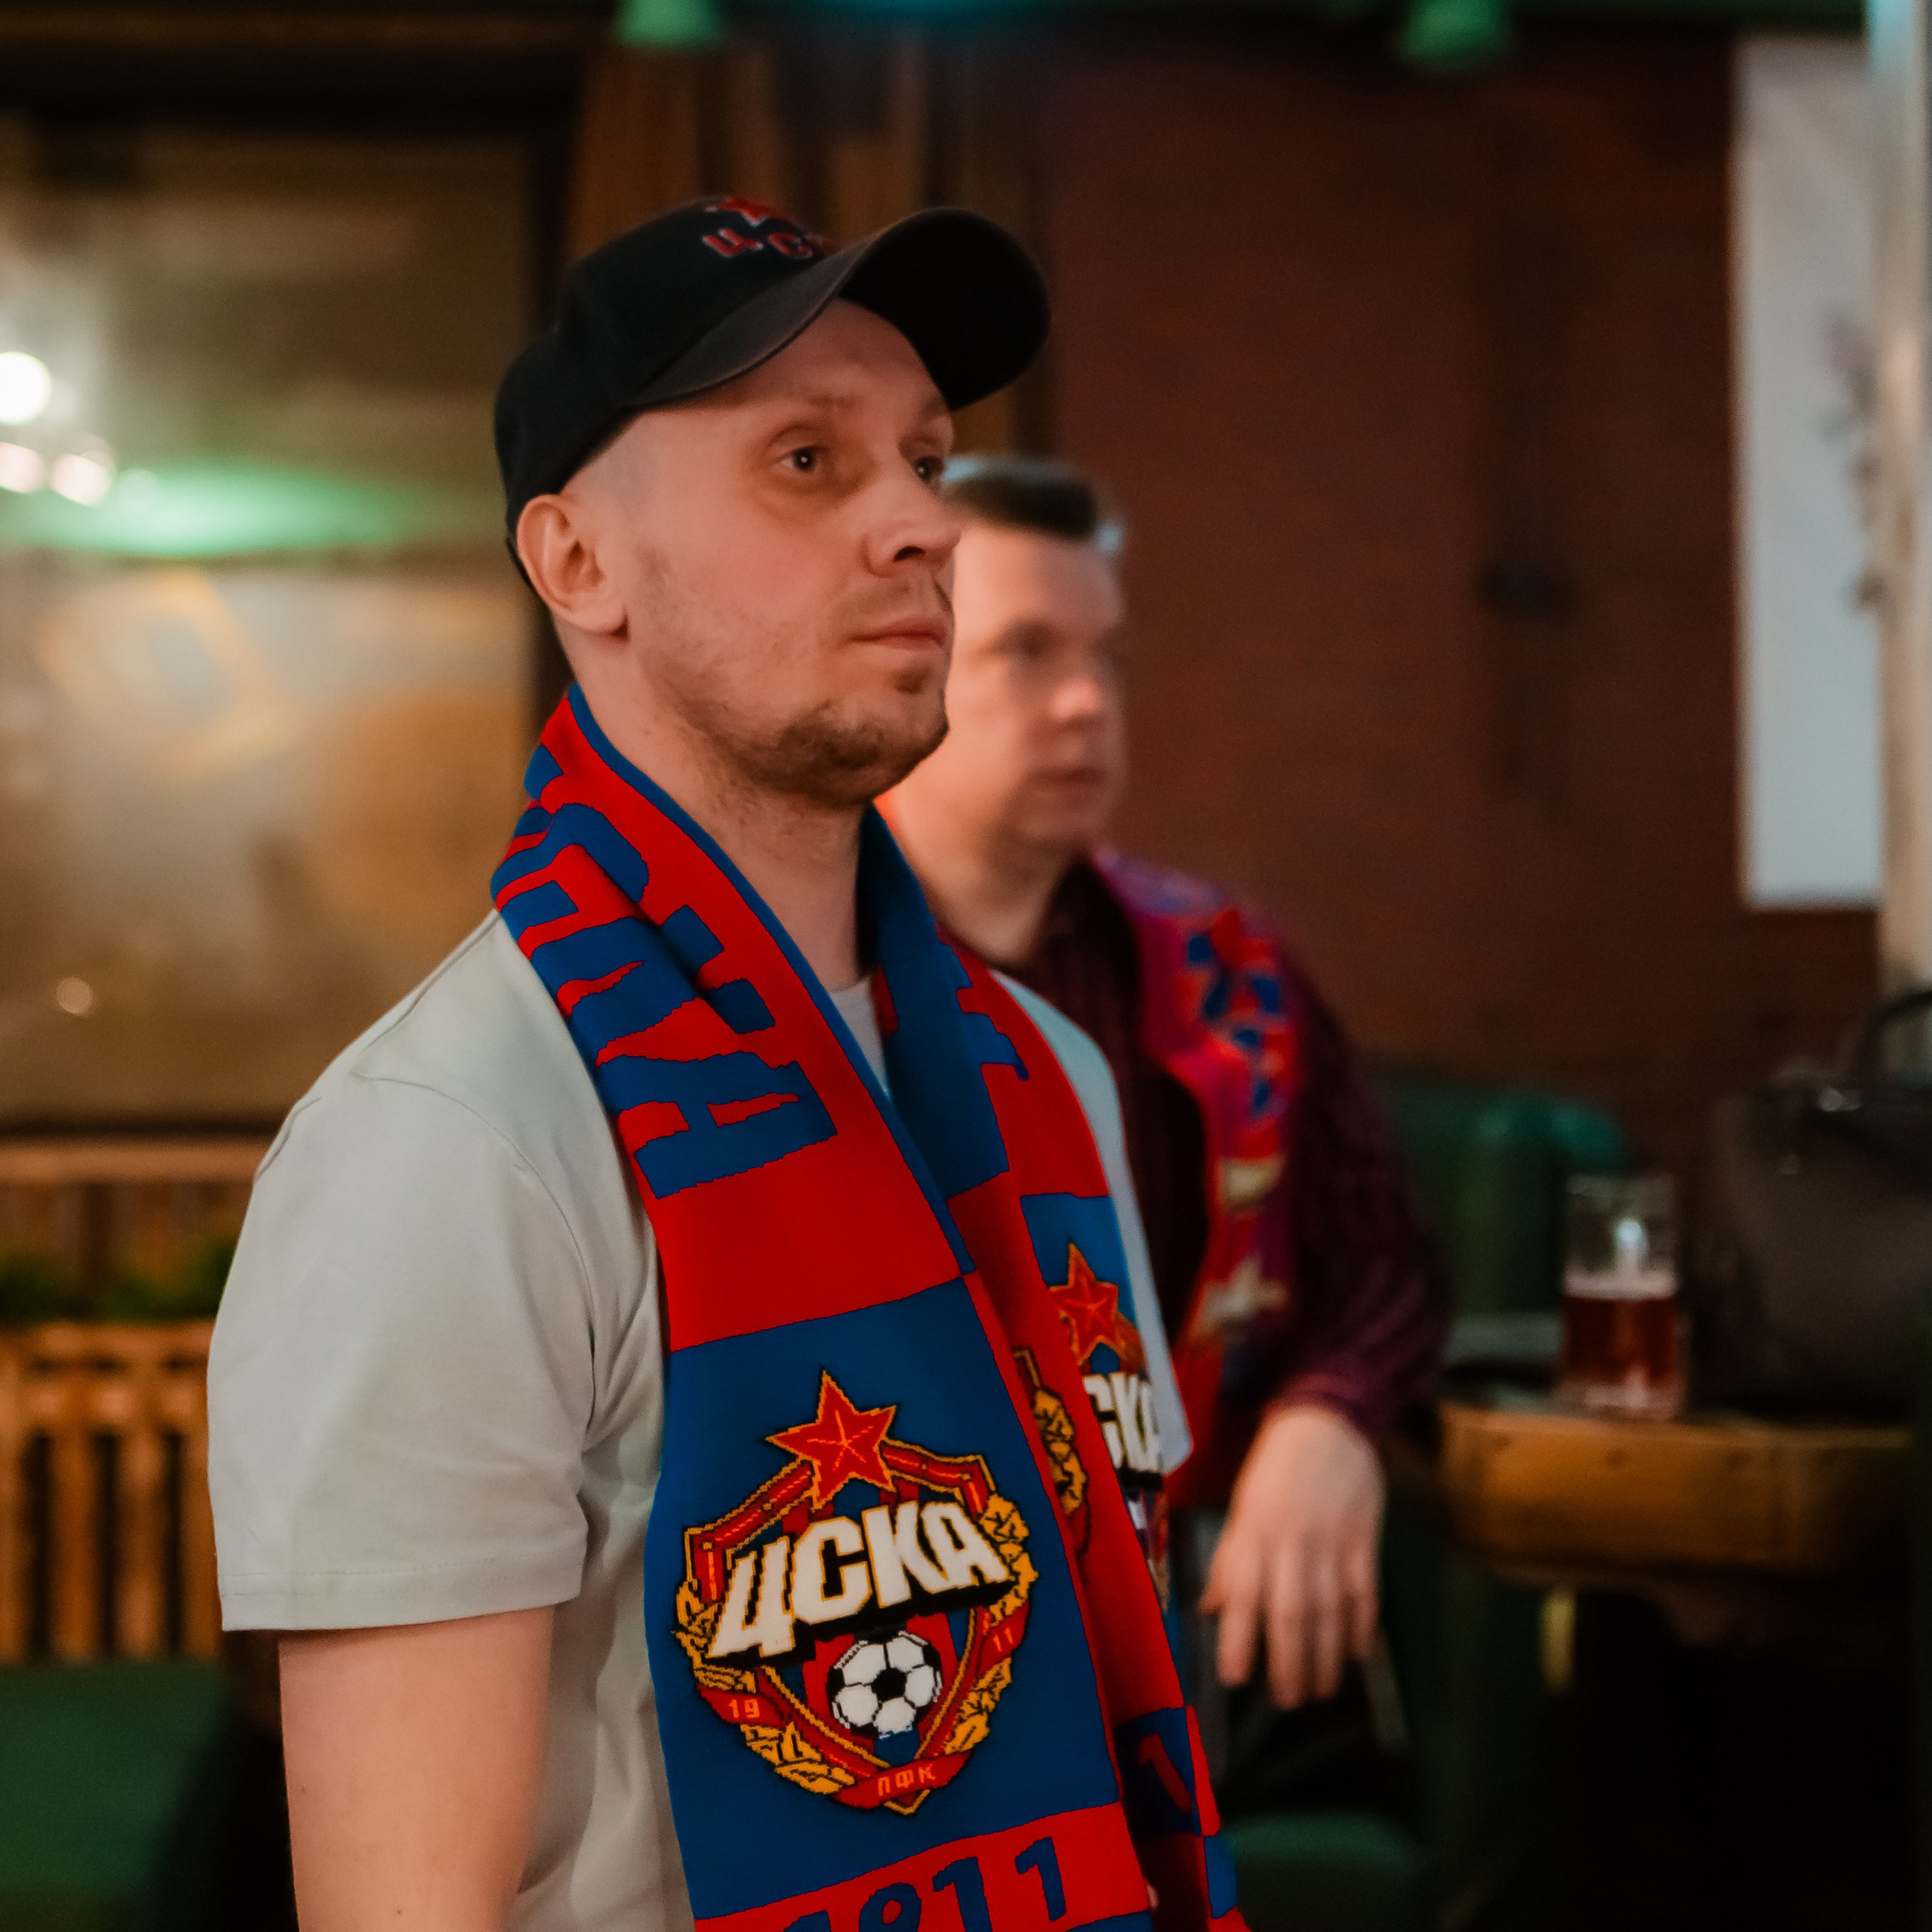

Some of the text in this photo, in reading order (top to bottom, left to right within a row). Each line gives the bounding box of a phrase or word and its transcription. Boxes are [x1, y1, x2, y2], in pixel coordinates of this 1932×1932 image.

[707, 1500, 1011, 1659] ЦСКА
[992, 1627, 1014, 1652] 11
[728, 1698, 761, 1718] 19
[878, 1764, 936, 1797] ПФК
[781, 1836, 1066, 1932] 911
